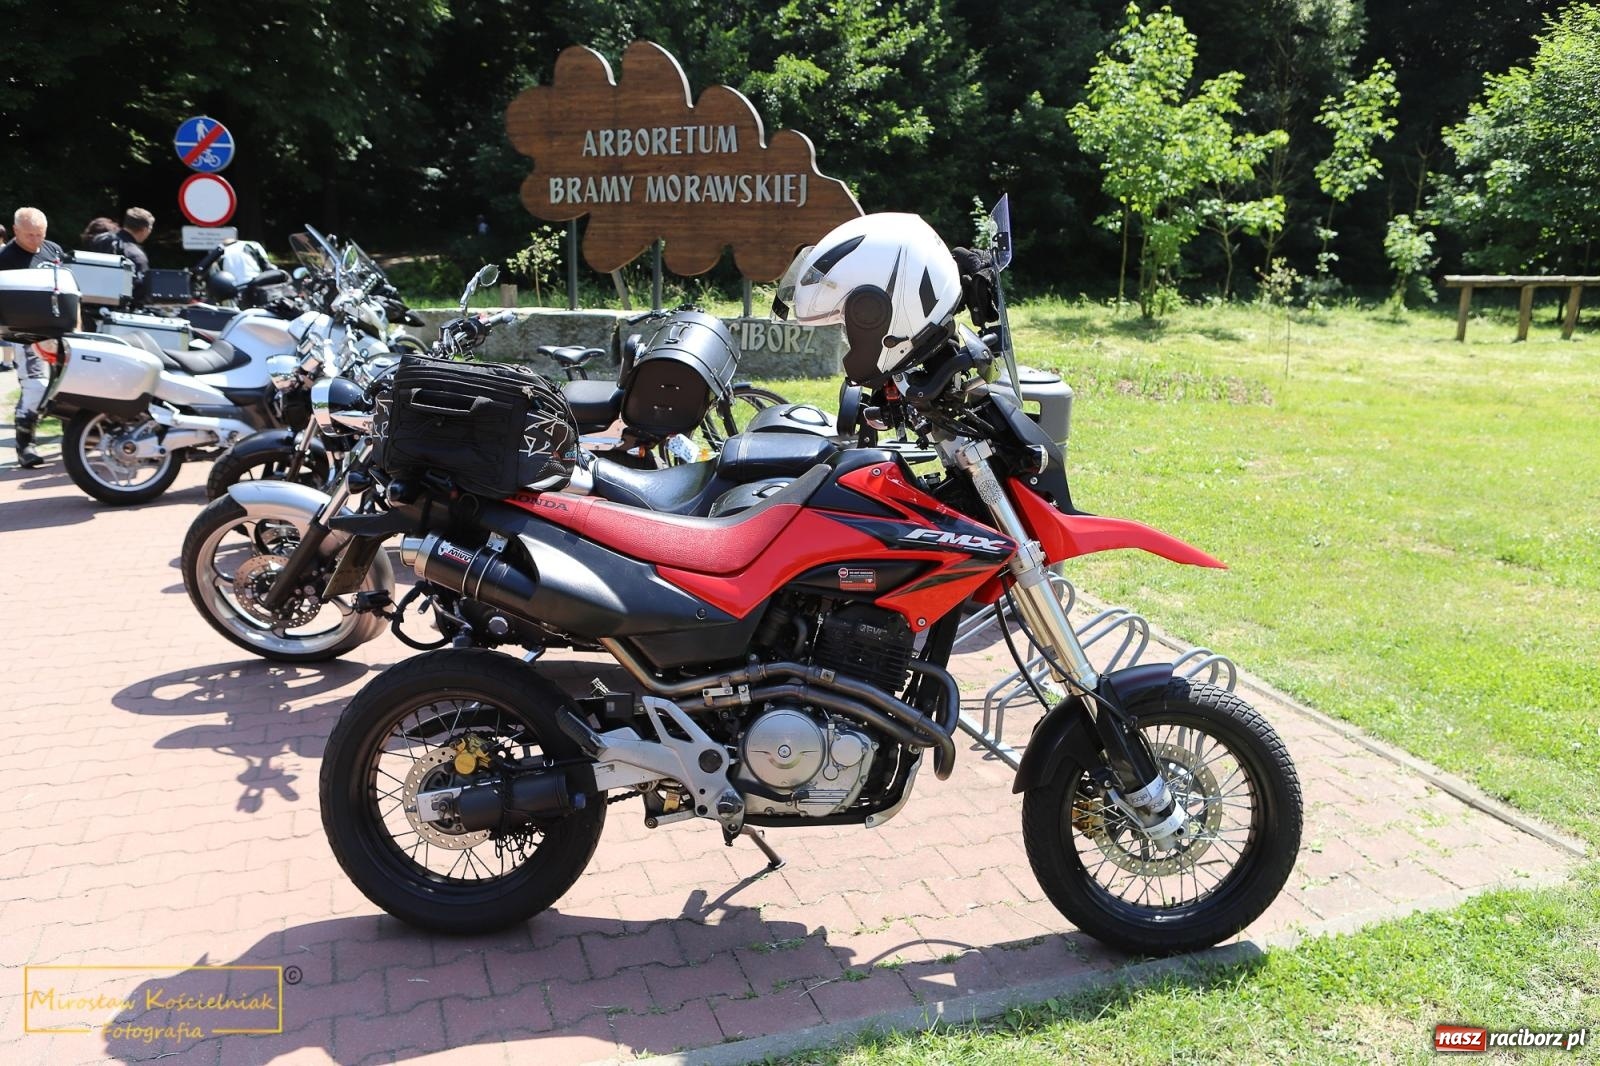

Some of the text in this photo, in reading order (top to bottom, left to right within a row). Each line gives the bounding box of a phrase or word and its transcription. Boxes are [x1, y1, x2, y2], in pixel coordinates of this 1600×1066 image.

[582, 125, 738, 157] ARBORETUM
[549, 174, 808, 207] BRAMY MORAWSKIEJ
[517, 493, 569, 511] ONDA
[903, 528, 1008, 551] FMX
